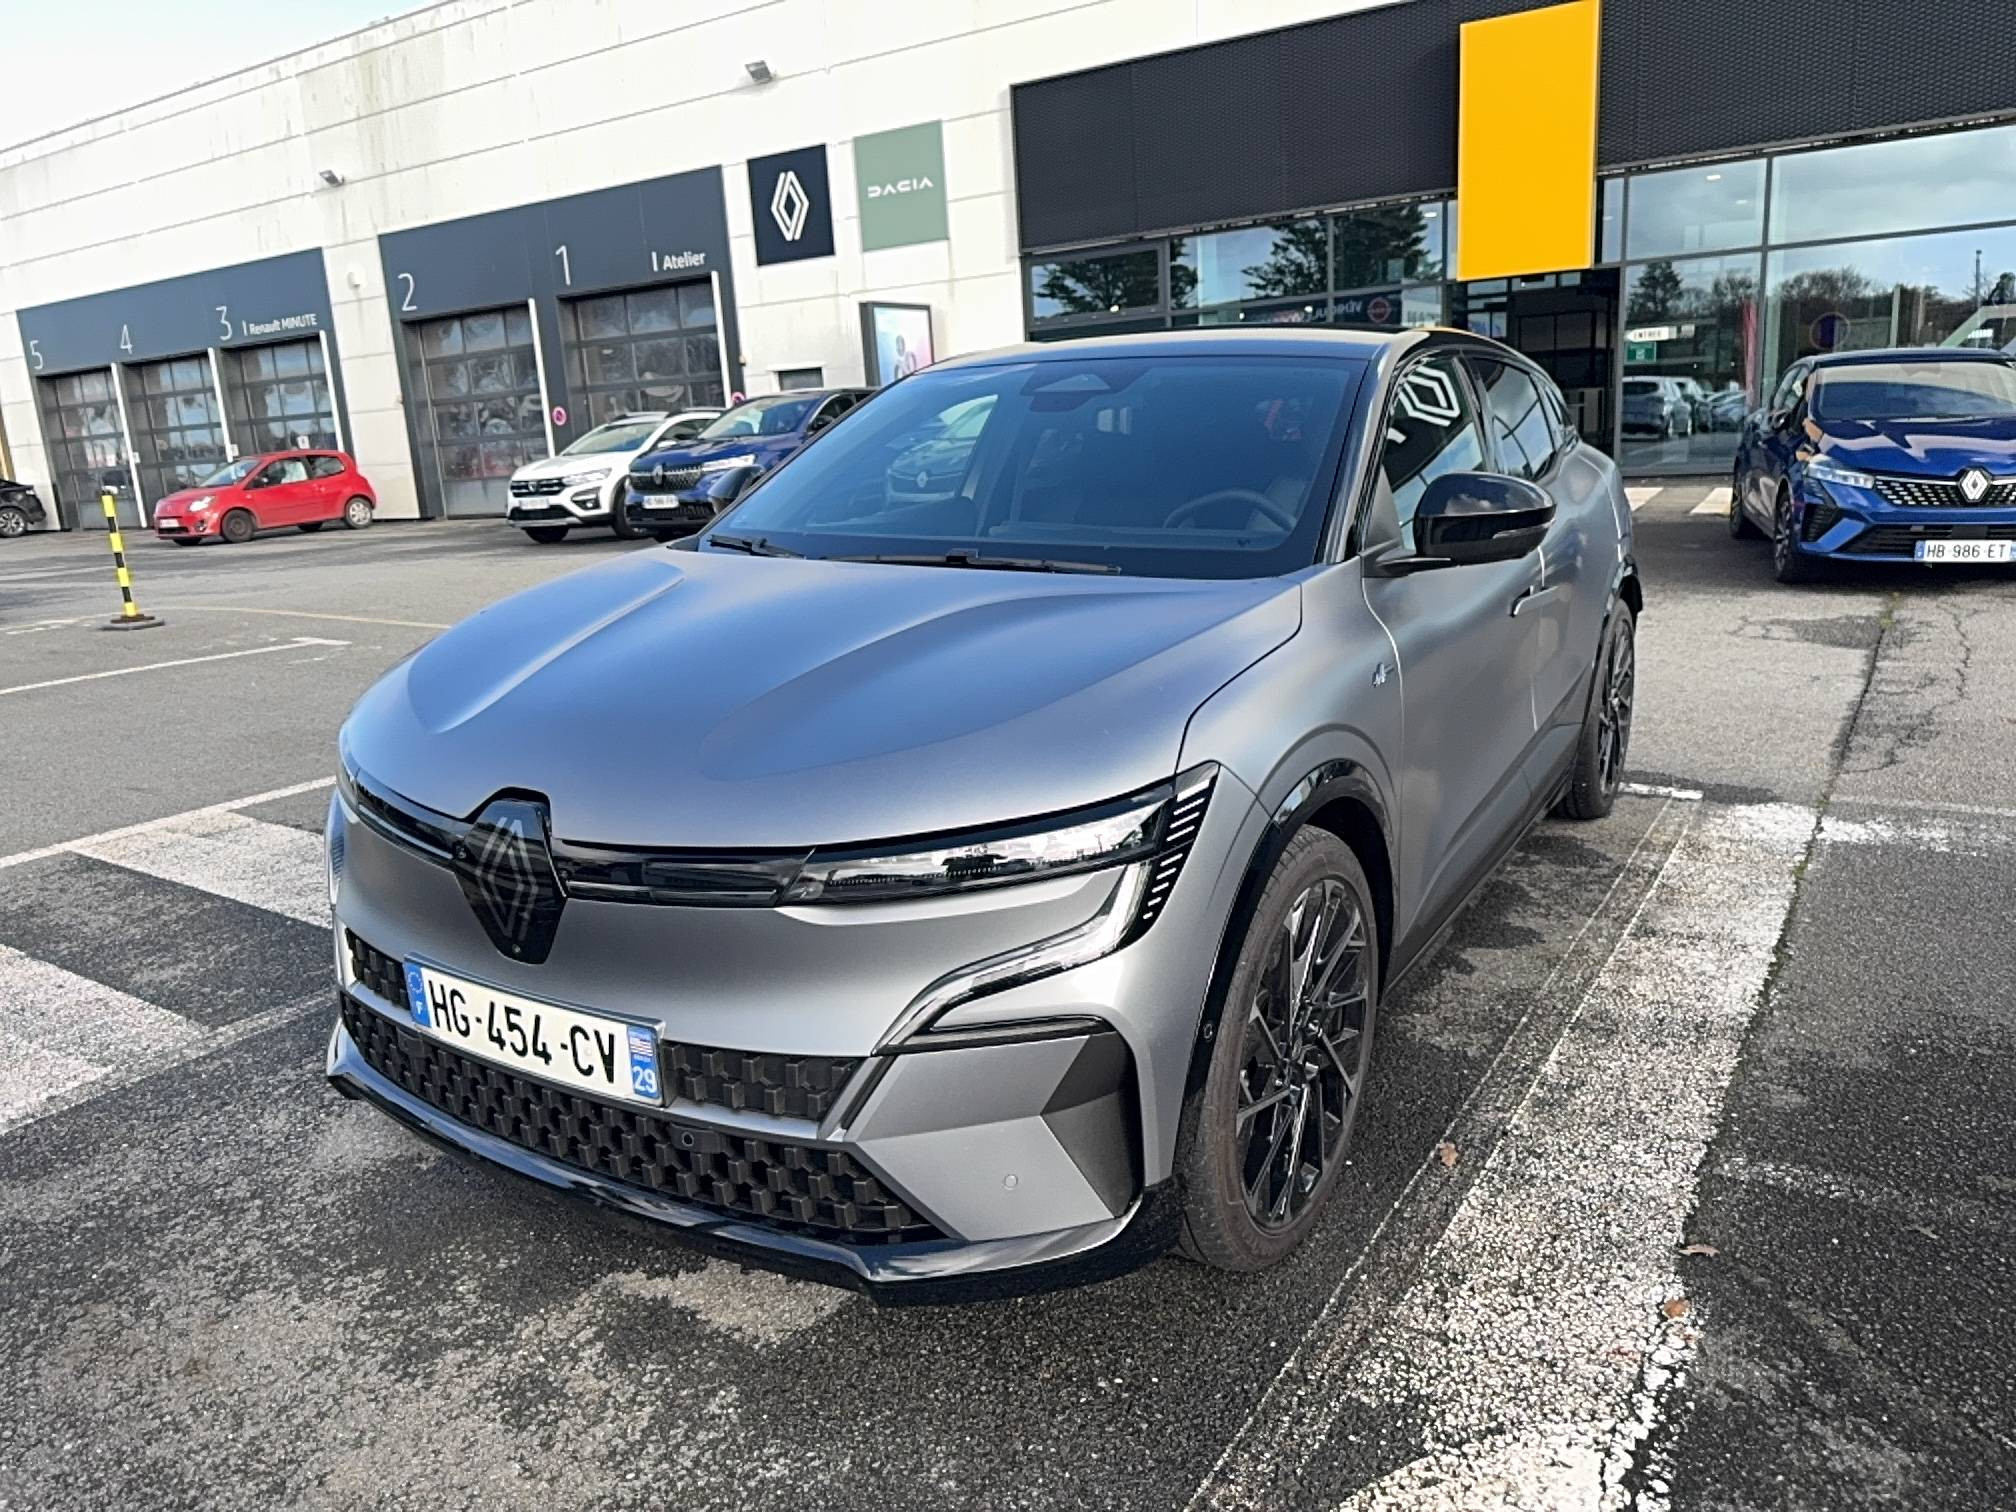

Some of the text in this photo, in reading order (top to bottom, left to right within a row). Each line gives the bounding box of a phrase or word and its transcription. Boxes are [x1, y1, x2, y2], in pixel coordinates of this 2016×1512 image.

[867, 176, 934, 198] DACIA
[555, 245, 571, 285] 1
[663, 251, 706, 270] Atelier
[398, 273, 417, 311] 2
[216, 306, 232, 340] 3
[281, 313, 317, 330] MINUTE
[120, 324, 132, 354] 4
[30, 340, 43, 370] 5
[632, 1065, 658, 1094] 29
